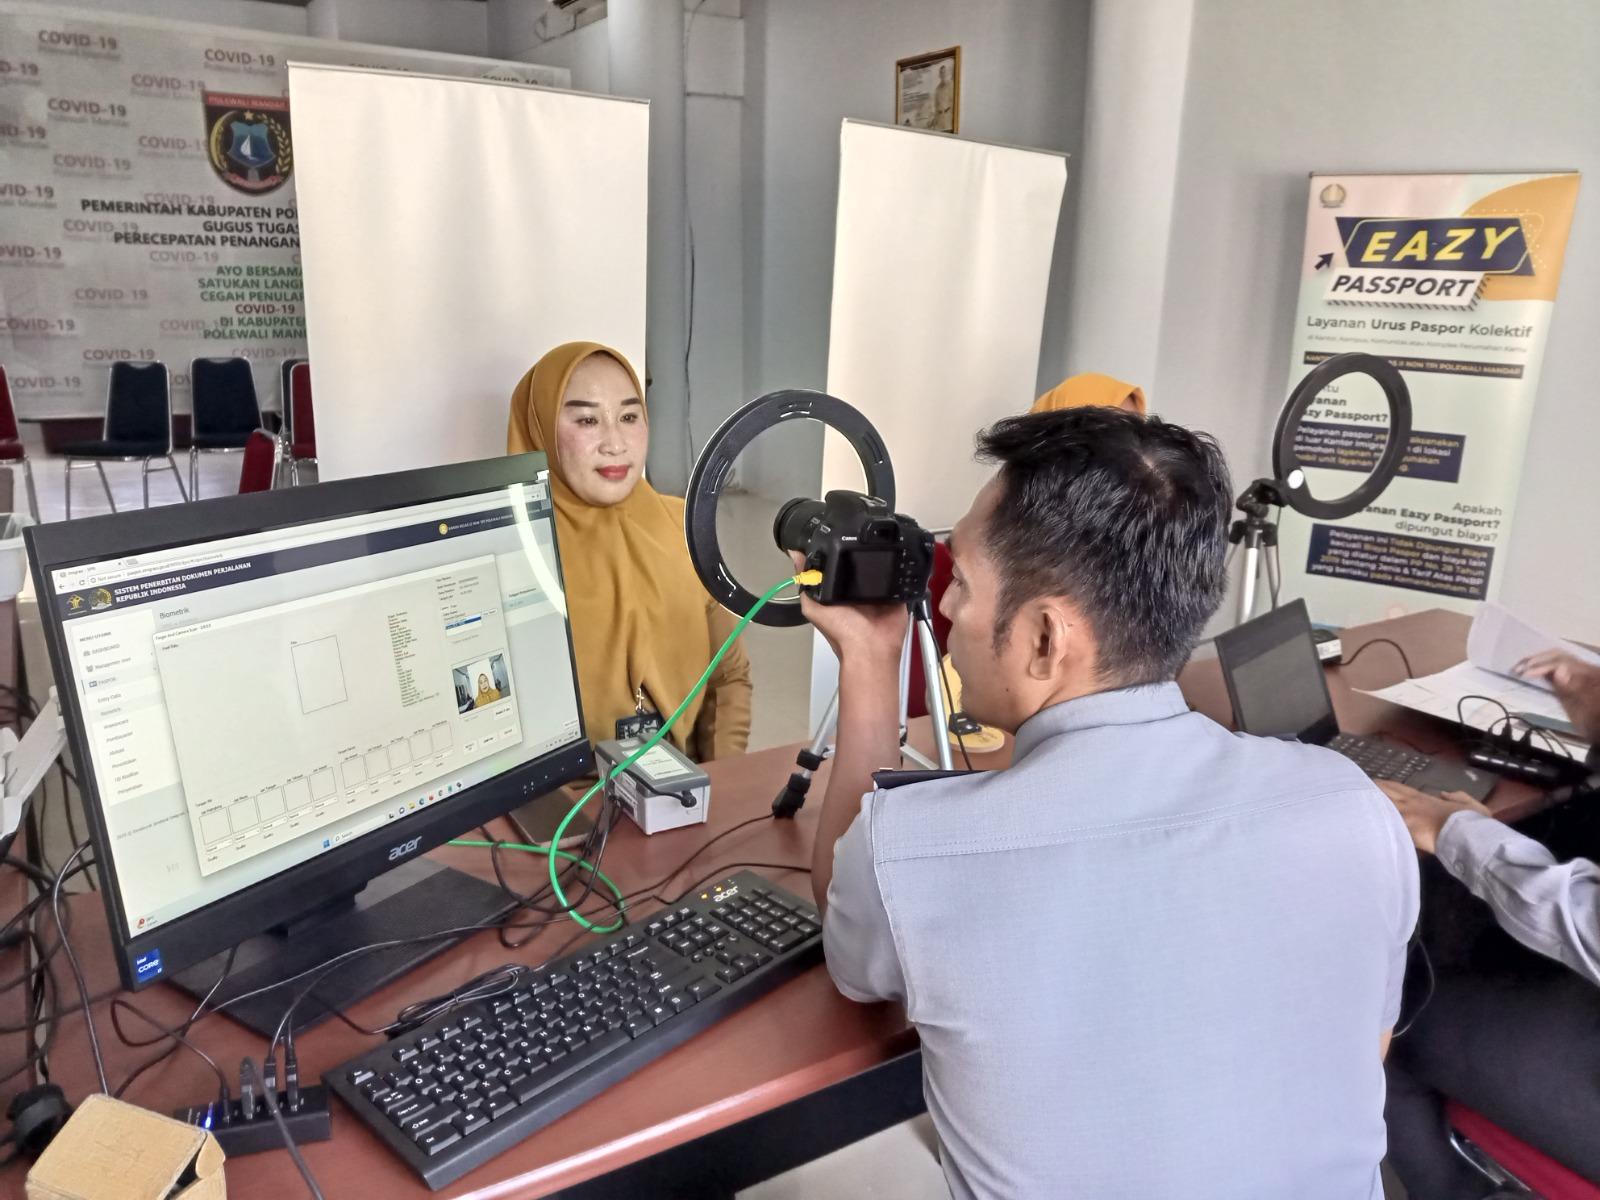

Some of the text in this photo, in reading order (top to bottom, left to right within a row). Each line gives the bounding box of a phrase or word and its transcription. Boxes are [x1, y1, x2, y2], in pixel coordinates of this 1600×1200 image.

[38, 29, 118, 50] COVID-19
[204, 48, 276, 66] COVID-19
[48, 98, 127, 117] COVID-19
[53, 154, 132, 171] COVID-19
[81, 198, 182, 215] PEMERINTAH
[187, 204, 272, 218] KABUPATEN
[202, 220, 253, 233] GUGUS
[114, 231, 300, 248] PERECEPATAN PENANGAN
[1360, 226, 1520, 263] EAZY
[216, 265, 243, 276] AYO
[198, 278, 260, 289] SATUKAN
[1331, 274, 1476, 298] PASSPORT
[75, 288, 148, 301] COVID-19
[200, 290, 245, 301] CEGAH
[235, 304, 295, 314] COVID-19
[220, 316, 233, 327] DI
[1307, 316, 1533, 338] Layanan Urus Paspor Kolektif
[203, 329, 268, 339] POLEWALI
[83, 349, 155, 361] COVID-19
[1325, 409, 1388, 423] Passport?
[1452, 502, 1502, 516] Apakah
[1400, 508, 1431, 522] Eazy
[1434, 512, 1501, 529] Passport?
[1395, 520, 1499, 543] dipungut biaya?
[114, 584, 140, 596] SISTEM
[140, 576, 181, 590] PENERBITAN
[181, 569, 213, 581] DOKUMEN
[213, 561, 252, 575] PERJALANAN
[115, 582, 187, 603] REPUBLIK INDONESIA
[388, 835, 423, 861] acer
[713, 885, 739, 902] acer
